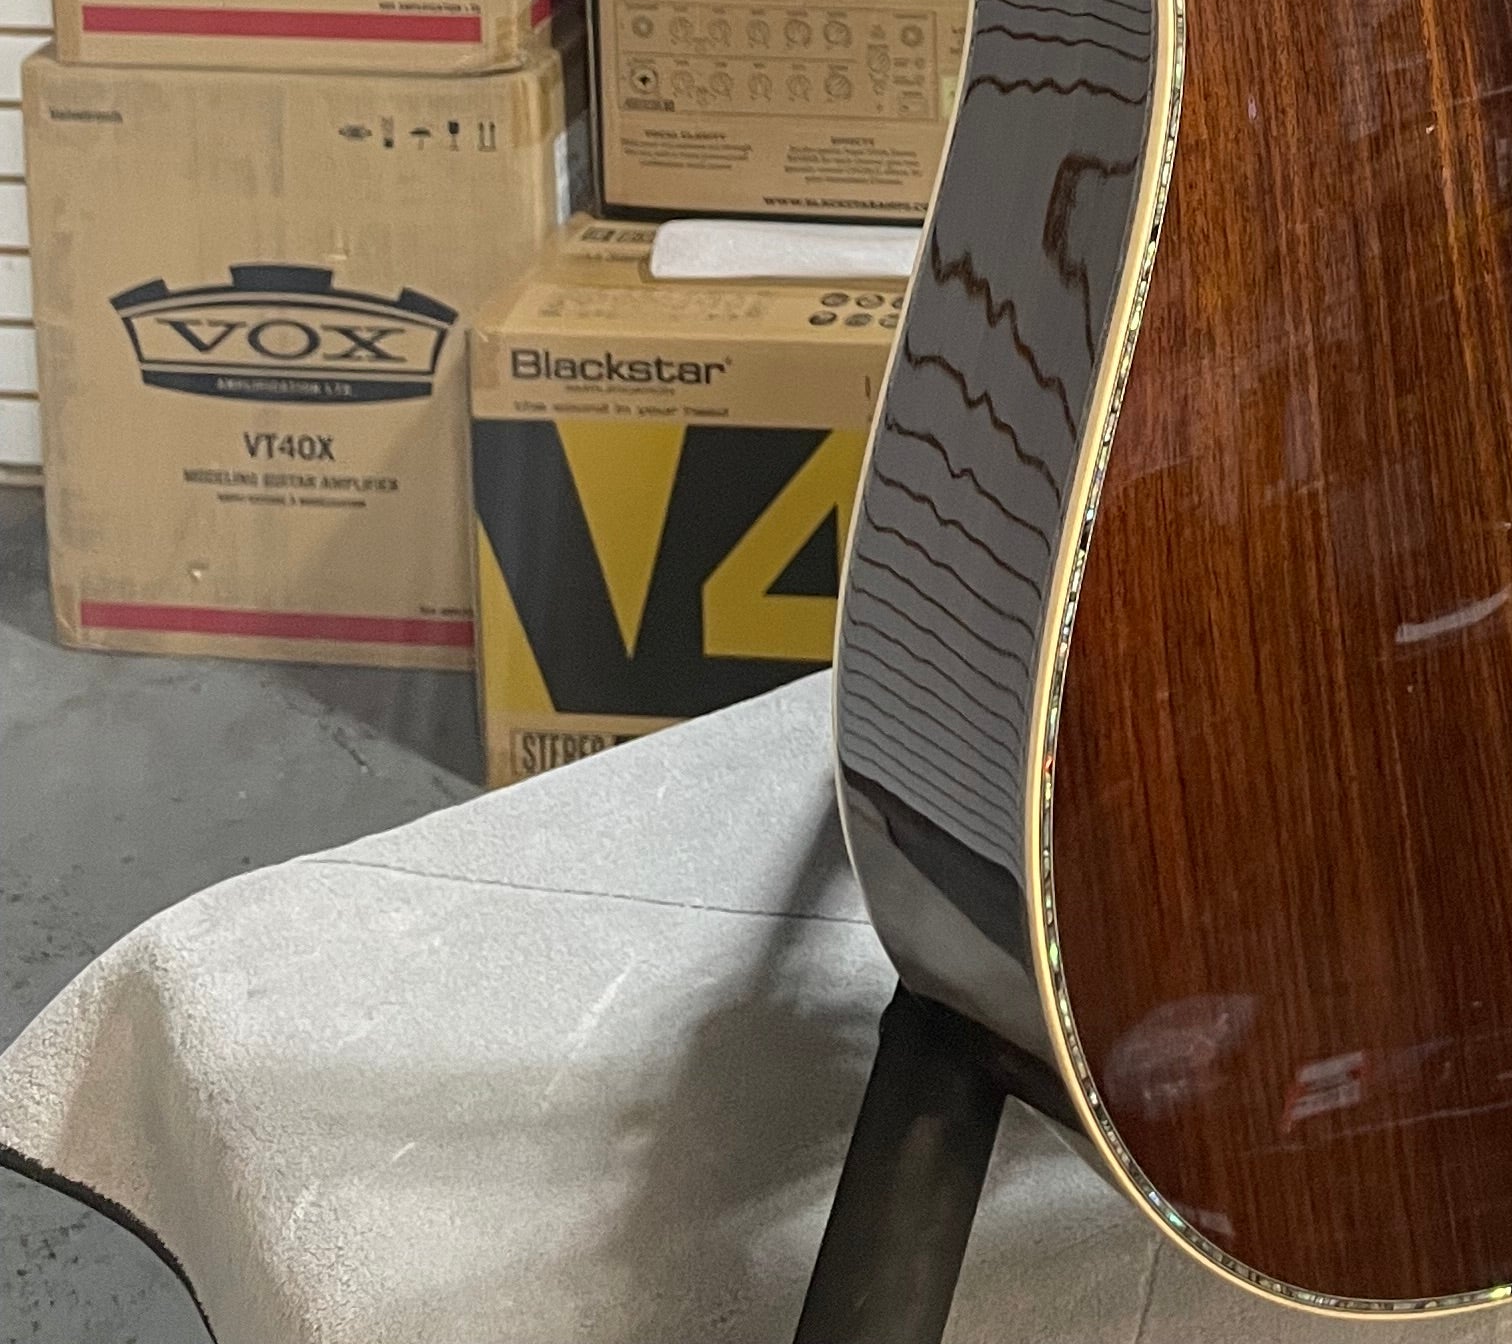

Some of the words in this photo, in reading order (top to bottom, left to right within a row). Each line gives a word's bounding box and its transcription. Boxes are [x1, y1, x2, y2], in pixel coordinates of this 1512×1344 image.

[155, 318, 408, 363] VOX
[511, 347, 727, 385] Blackstar
[243, 430, 336, 462] VT40X
